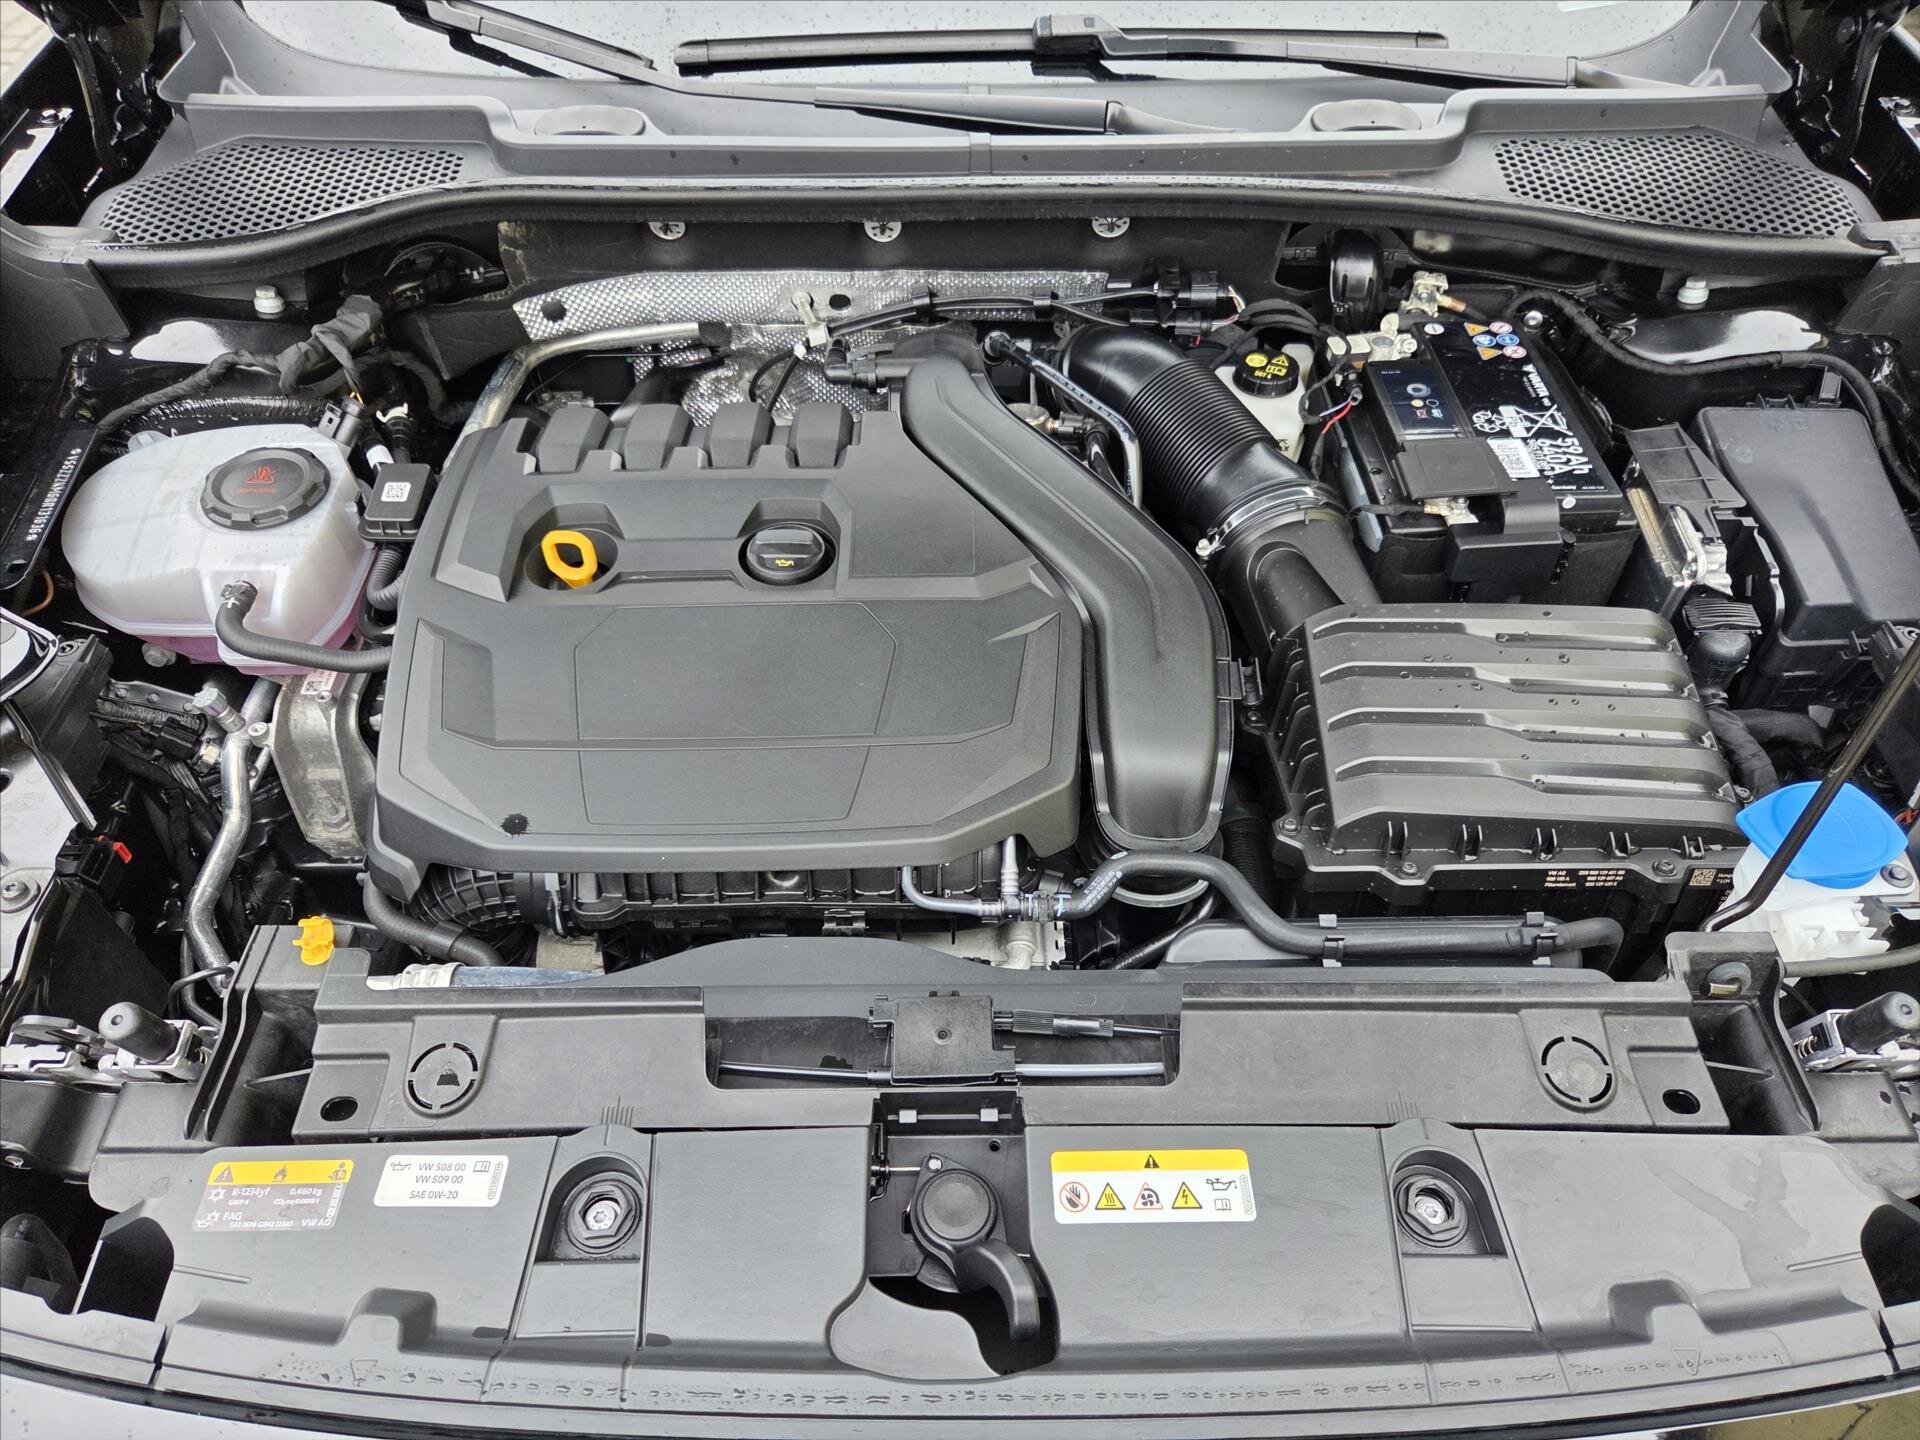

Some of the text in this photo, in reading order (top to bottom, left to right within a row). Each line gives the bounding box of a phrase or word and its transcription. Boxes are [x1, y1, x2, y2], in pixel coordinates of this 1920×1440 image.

[1537, 438, 1573, 476] 640A
[1557, 437, 1593, 475] 59Ah
[419, 1162, 467, 1172] VW 508 00
[415, 1175, 464, 1184] VW 509 00
[231, 1187, 271, 1198] R-1234yf
[312, 1187, 323, 1198] kg
[409, 1190, 459, 1199] SAE 0W-20
[223, 1211, 243, 1221] PAG
[302, 1218, 333, 1227] VW AG
